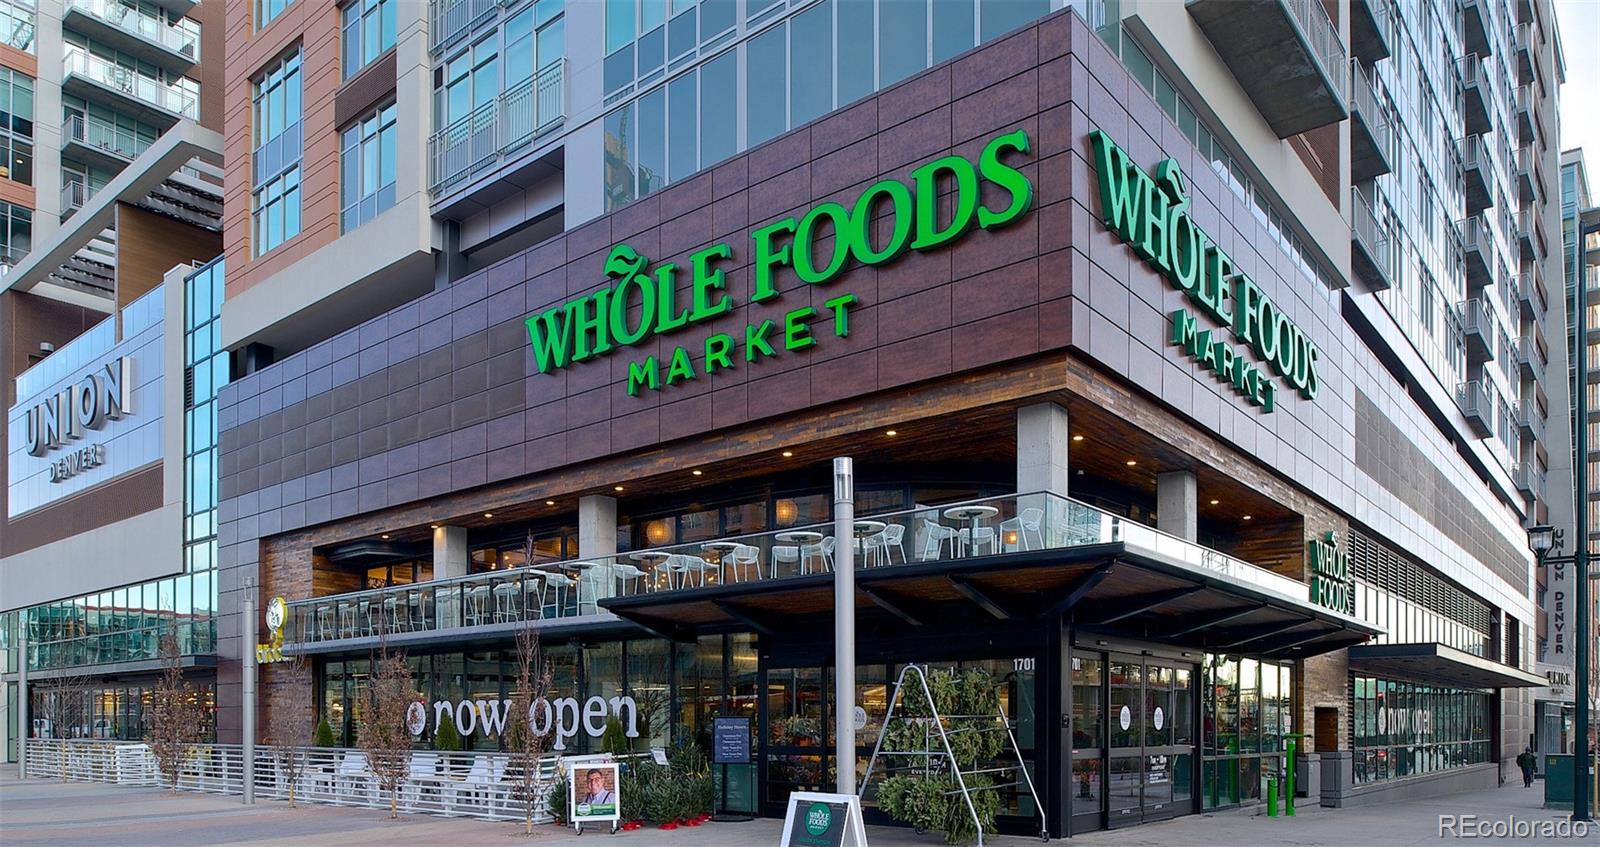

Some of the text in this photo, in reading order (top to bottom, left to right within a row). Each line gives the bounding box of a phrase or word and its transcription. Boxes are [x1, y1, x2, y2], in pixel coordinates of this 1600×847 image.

[525, 128, 1034, 374] WHOLE FOODS
[1089, 129, 1319, 400] WHOLE FOODS
[626, 293, 860, 397] MARKET
[1172, 308, 1279, 413] MARKET
[26, 356, 132, 458] UNION
[50, 443, 105, 483] DENVER
[1309, 530, 1351, 582] WHOLE
[1554, 528, 1565, 654] UNION DENVER
[1311, 576, 1351, 615] FOODS
[1013, 657, 1035, 671] 1701
[433, 695, 640, 750] now open
[1388, 707, 1433, 743] now open
